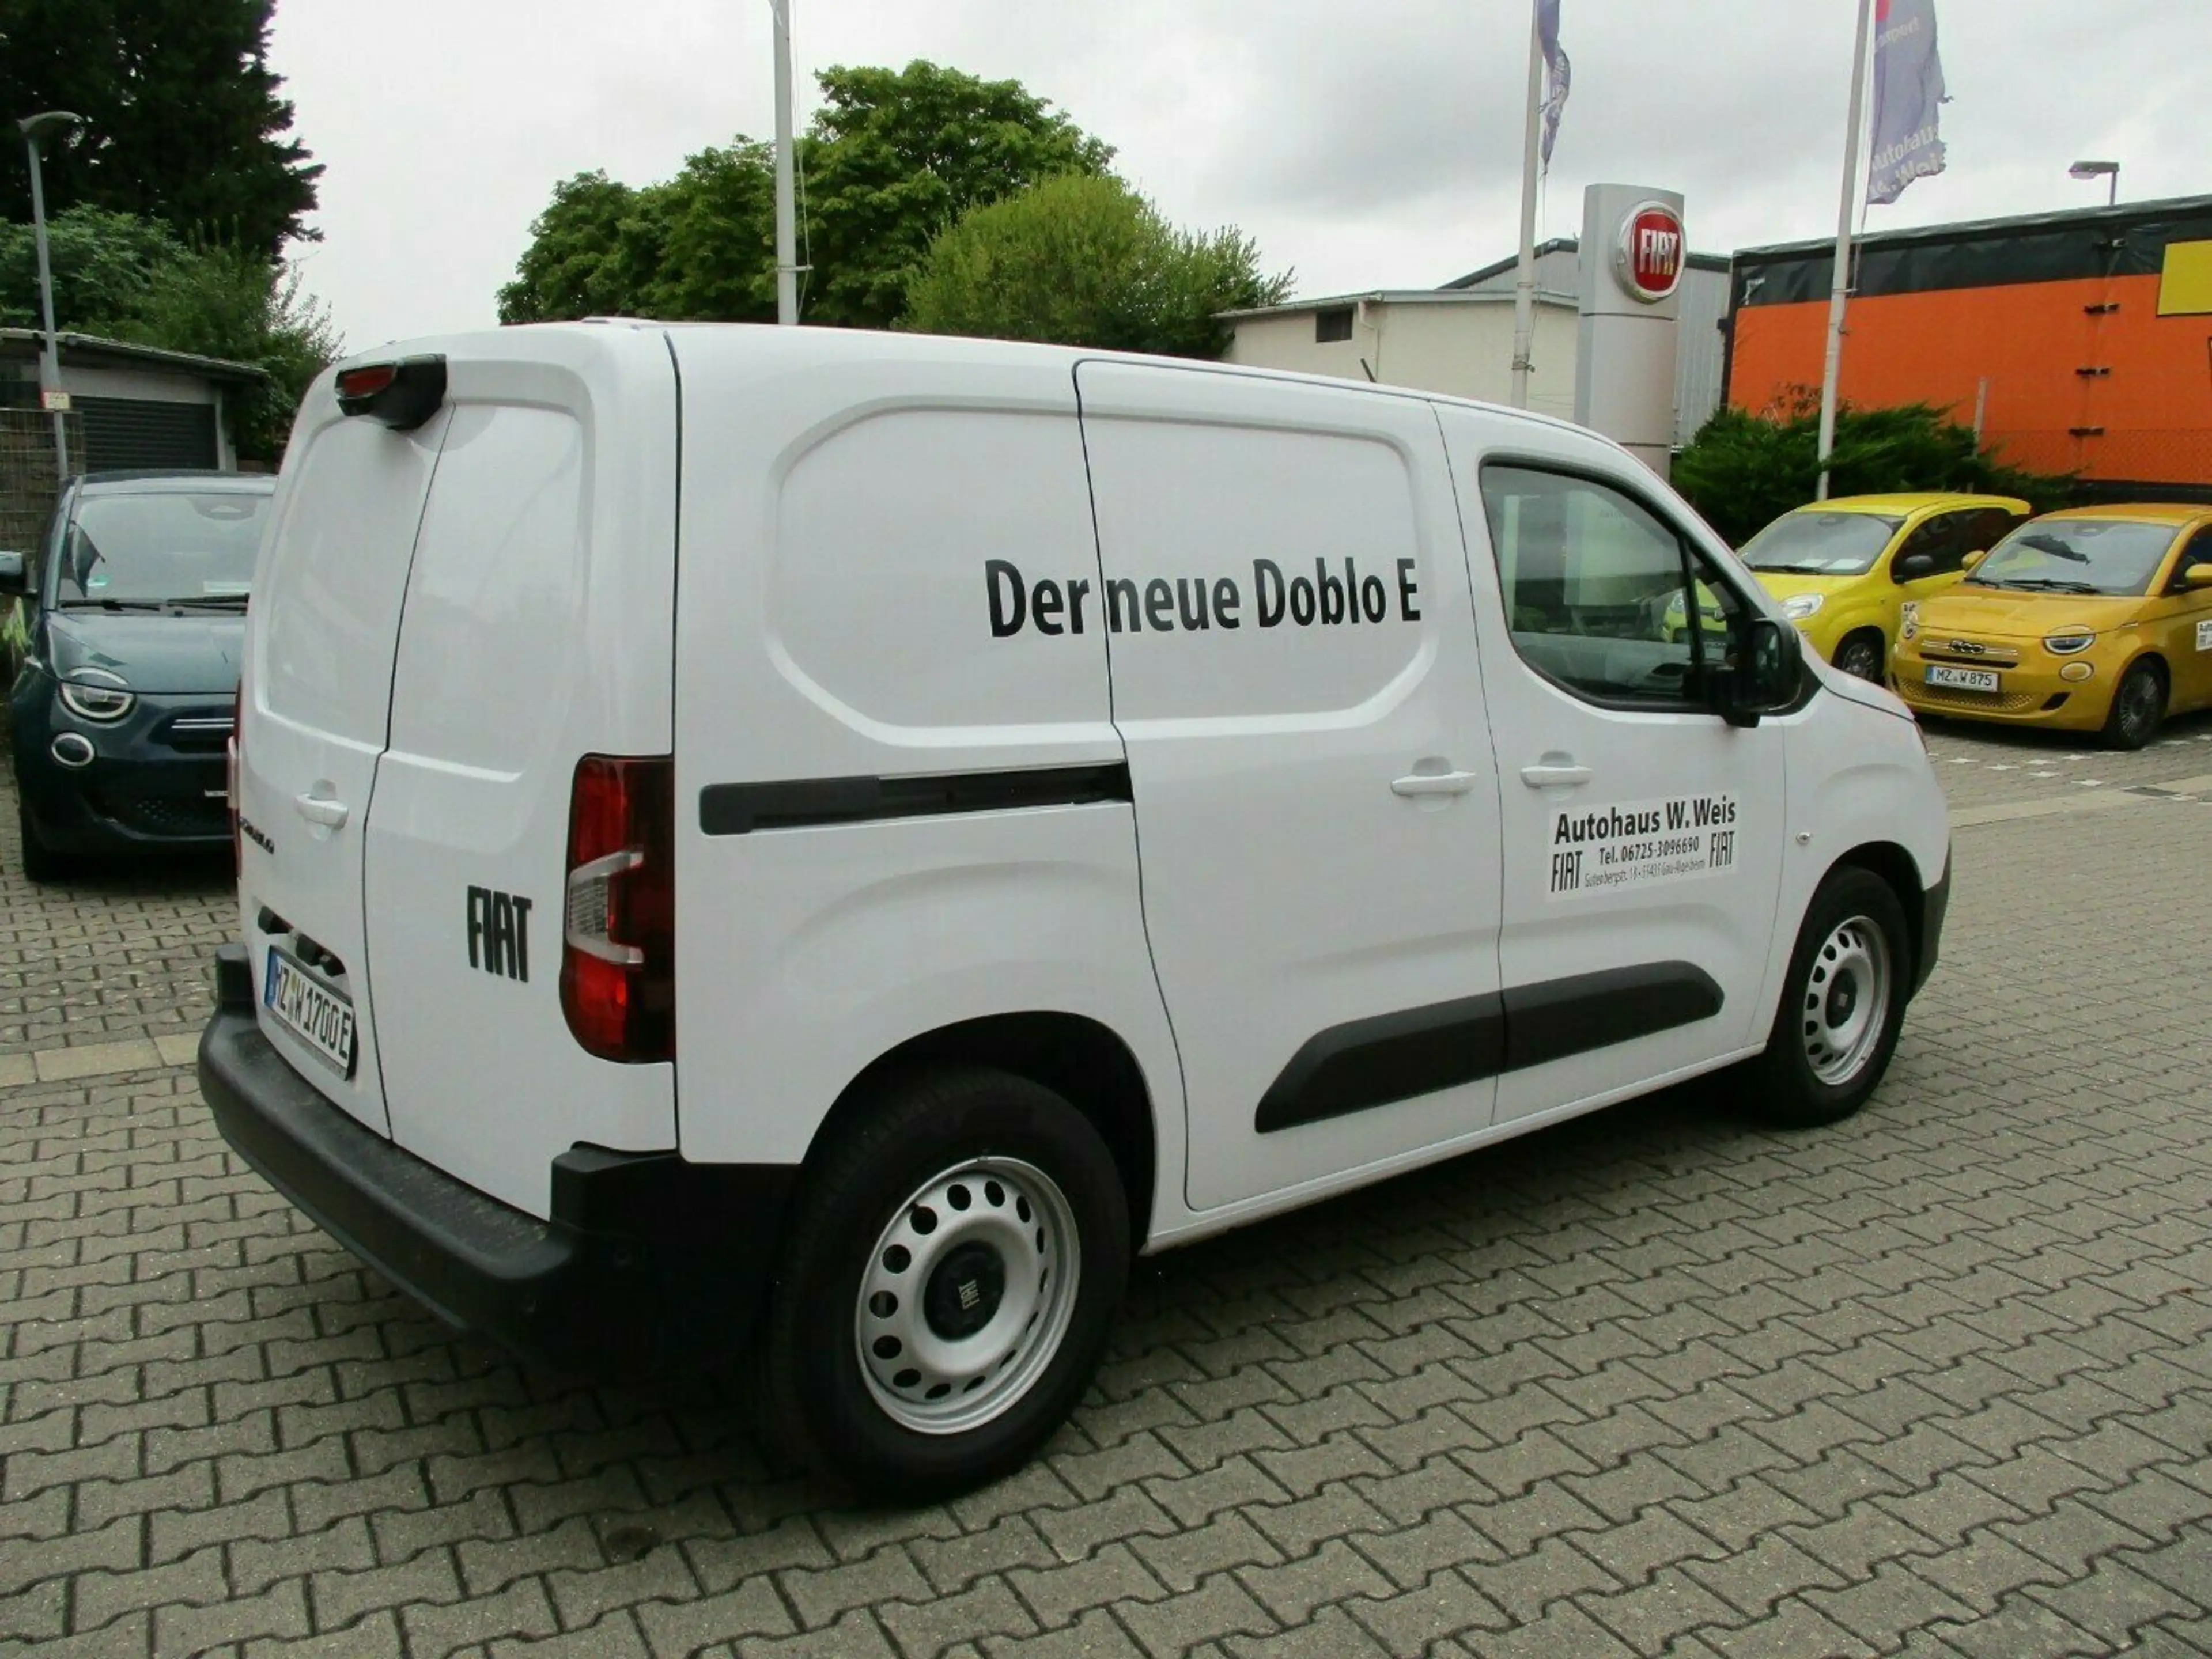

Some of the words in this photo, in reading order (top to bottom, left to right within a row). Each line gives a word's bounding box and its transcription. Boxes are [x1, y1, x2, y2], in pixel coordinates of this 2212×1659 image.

[1640, 228, 1678, 275] FIAT
[985, 559, 1090, 638] Der
[1106, 577, 1241, 633] neue
[1253, 556, 1386, 628] Doblo
[1397, 558, 1421, 622] E
[1937, 669, 1952, 681] MZ
[1969, 672, 1992, 686] 875
[1554, 806, 1661, 845] Autohaus
[1666, 801, 1690, 830] W.
[1693, 794, 1736, 827] Weis
[1551, 850, 1583, 892] FIAT
[1599, 846, 1618, 865] Tel.
[1709, 831, 1735, 868] FIAT
[467, 885, 532, 983] FIAT
[304, 987, 351, 1060] 1700E
